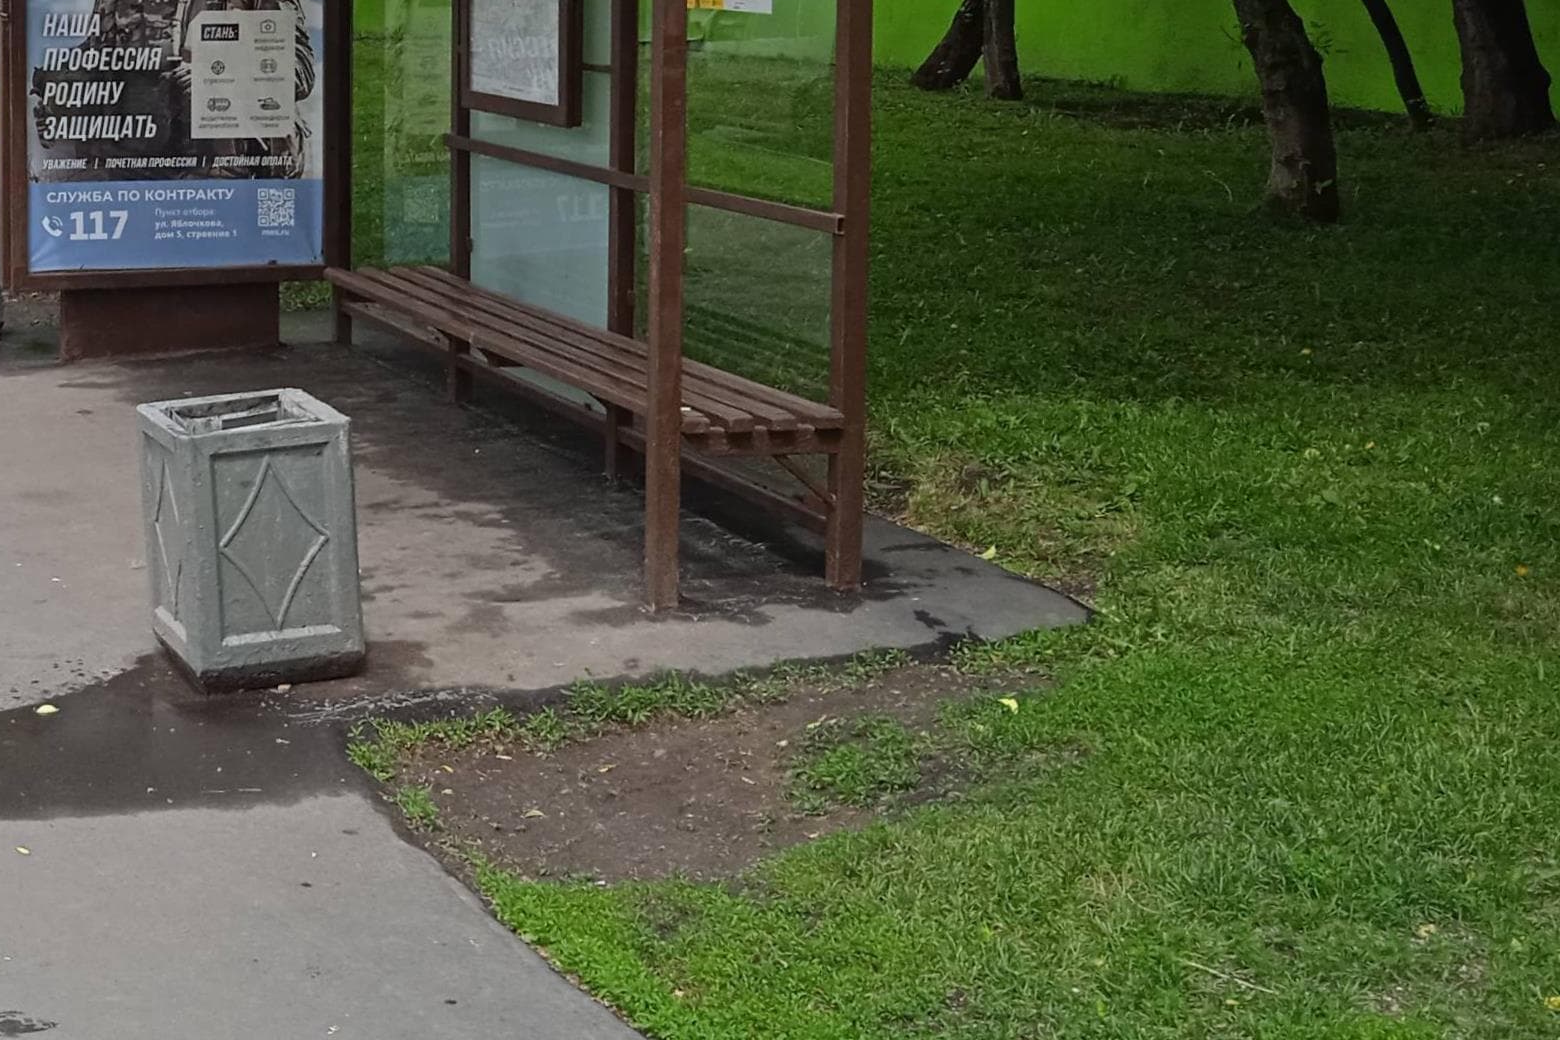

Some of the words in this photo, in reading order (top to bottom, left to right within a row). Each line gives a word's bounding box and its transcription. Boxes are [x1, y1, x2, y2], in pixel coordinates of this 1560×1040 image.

[42, 13, 101, 37] НАША
[42, 47, 163, 72] ПРОФЕССИЯ
[42, 81, 125, 108] РОДИНУ
[42, 115, 158, 142] ЗАЩИЩАТЬ
[43, 157, 88, 170] УВАЖЕНИЕ
[104, 156, 148, 169] ПОЧЕТНАЯ
[148, 156, 198, 168] ПРОФЕССИЯ
[212, 154, 261, 169] ДОСТОЙНАЯ
[261, 155, 293, 167] ОПЛАТА
[46, 190, 114, 204] СЛУЖБА
[118, 190, 141, 202] ПО
[144, 188, 235, 201] КОНТРАКТУ
[154, 207, 181, 218] Пункт
[70, 209, 129, 241] 117
[154, 231, 175, 240] дом
